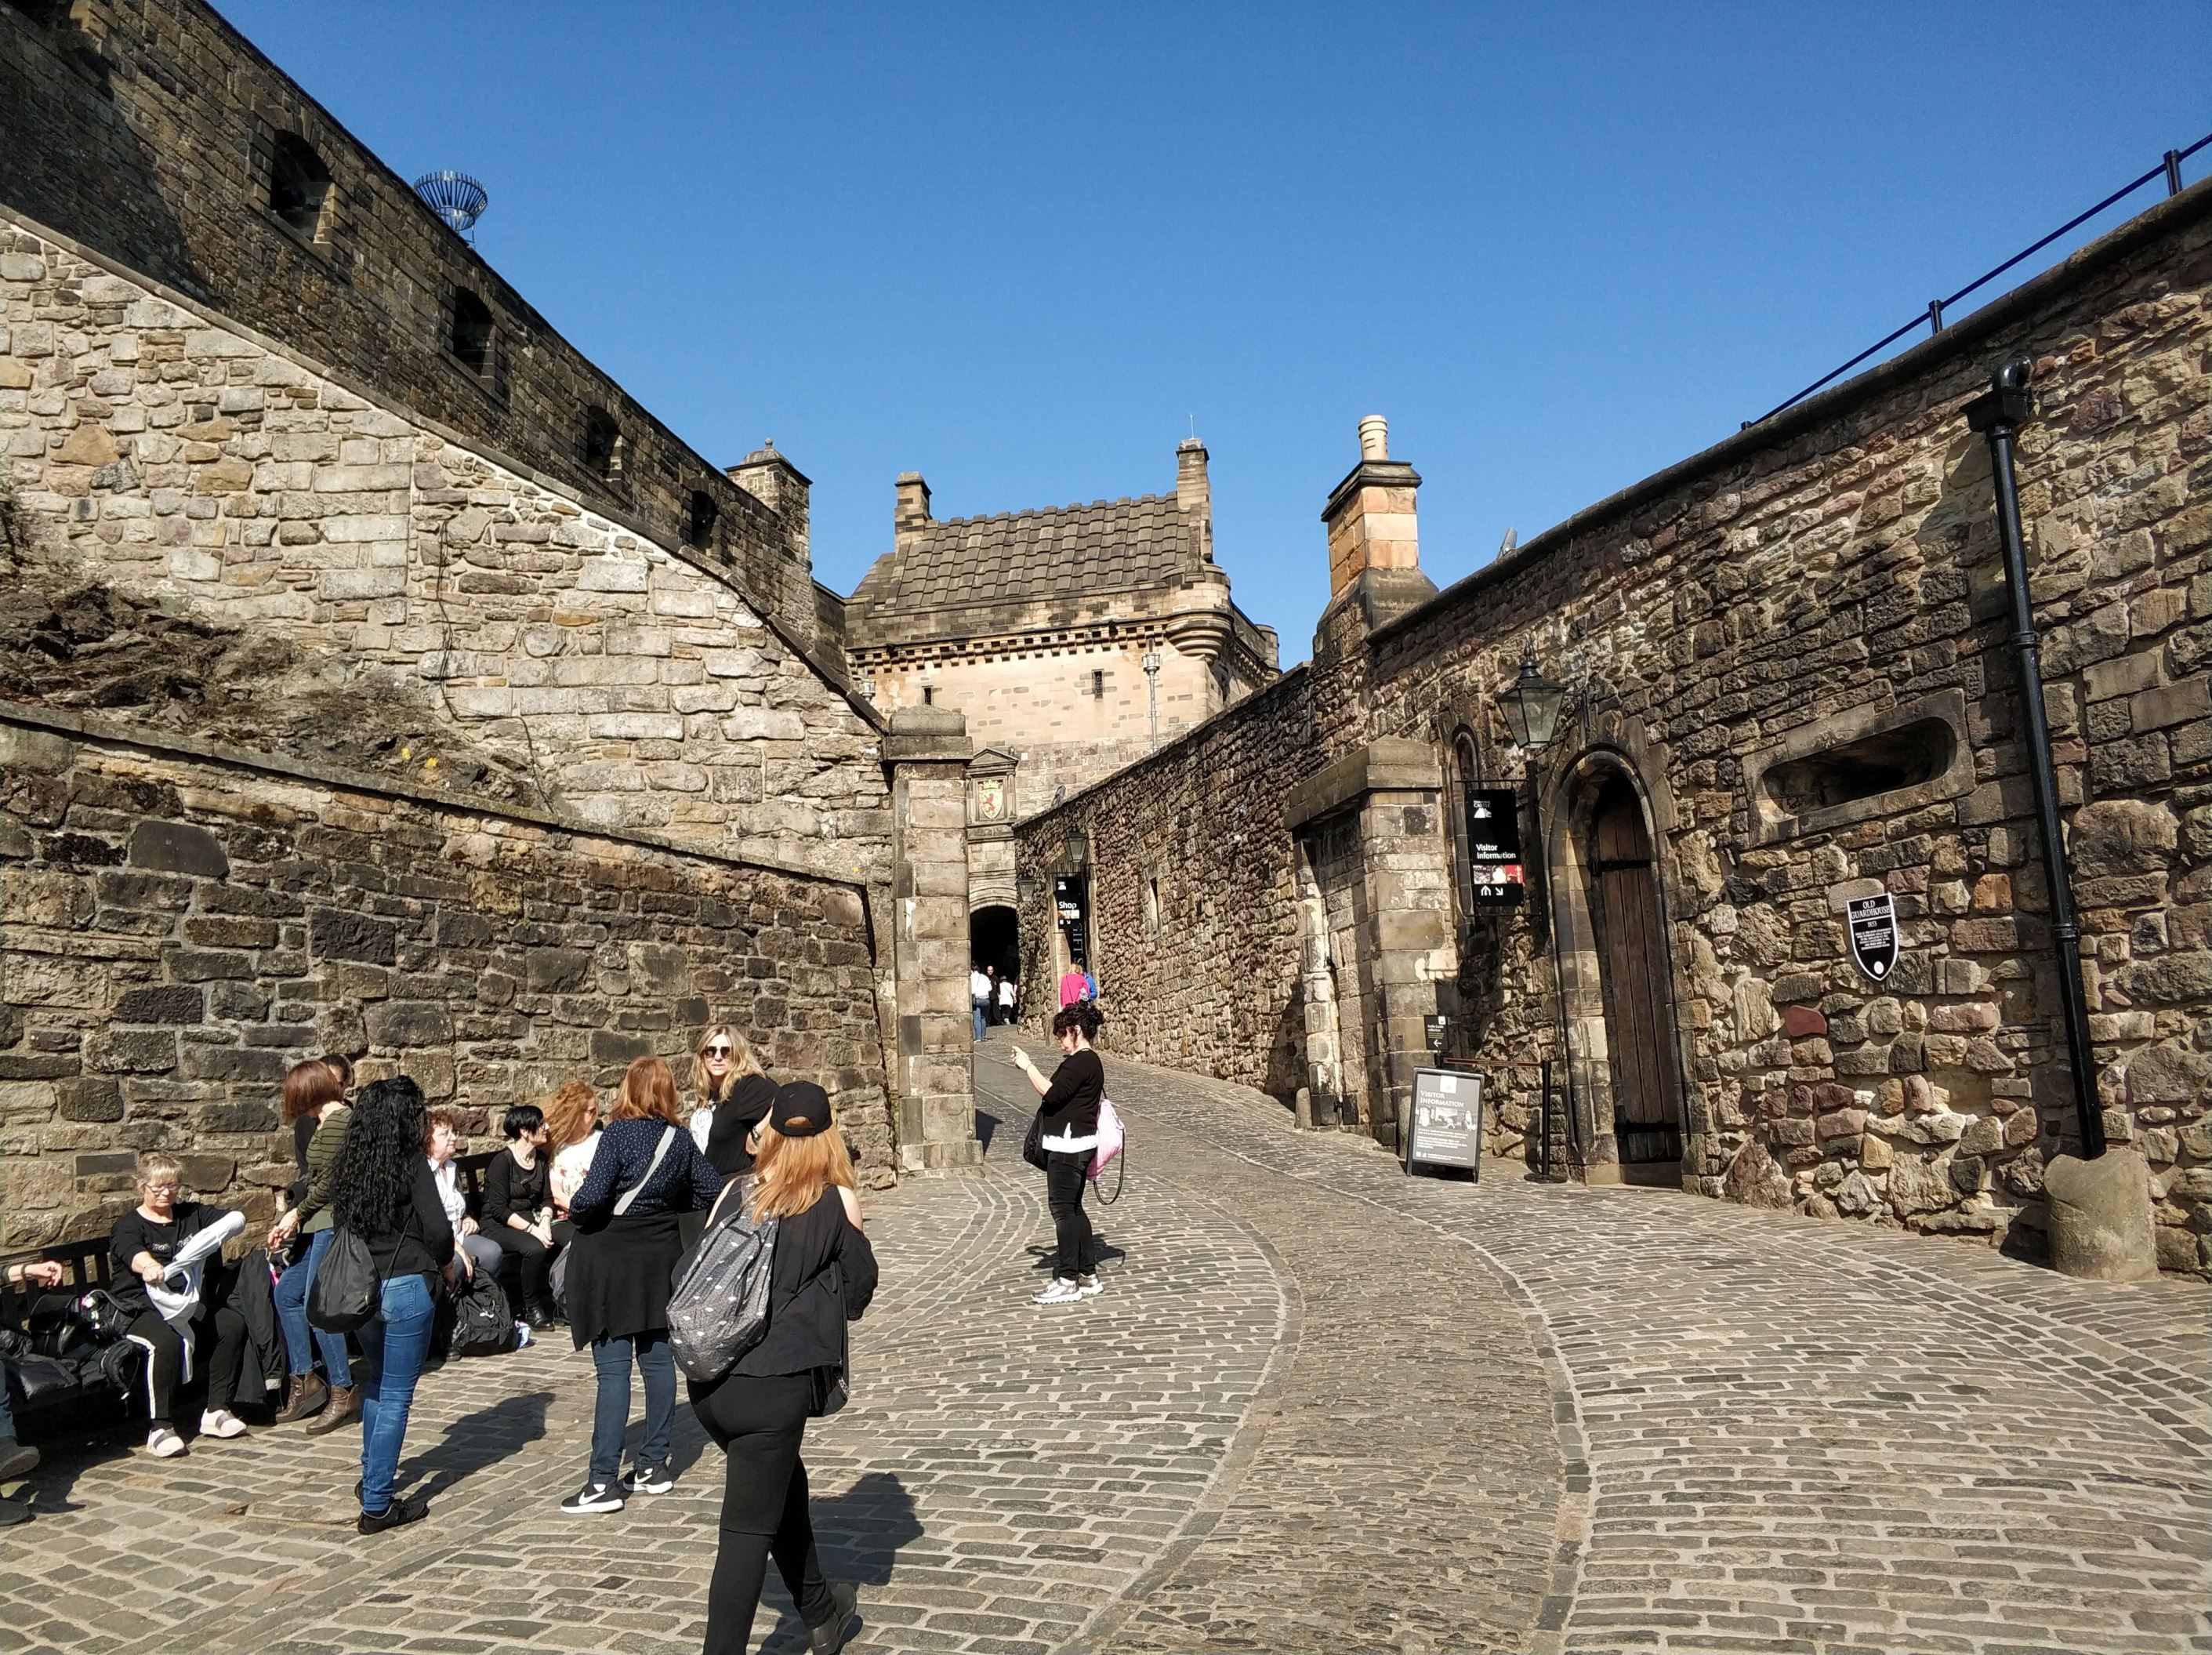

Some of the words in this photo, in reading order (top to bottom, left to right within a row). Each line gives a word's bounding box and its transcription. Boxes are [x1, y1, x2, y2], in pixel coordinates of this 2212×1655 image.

[1059, 901, 1077, 909] Shop
[1862, 900, 1876, 909] OLD
[1851, 906, 1891, 919] GUARDHOUSE
[1420, 1098, 1464, 1108] INFORMATION
